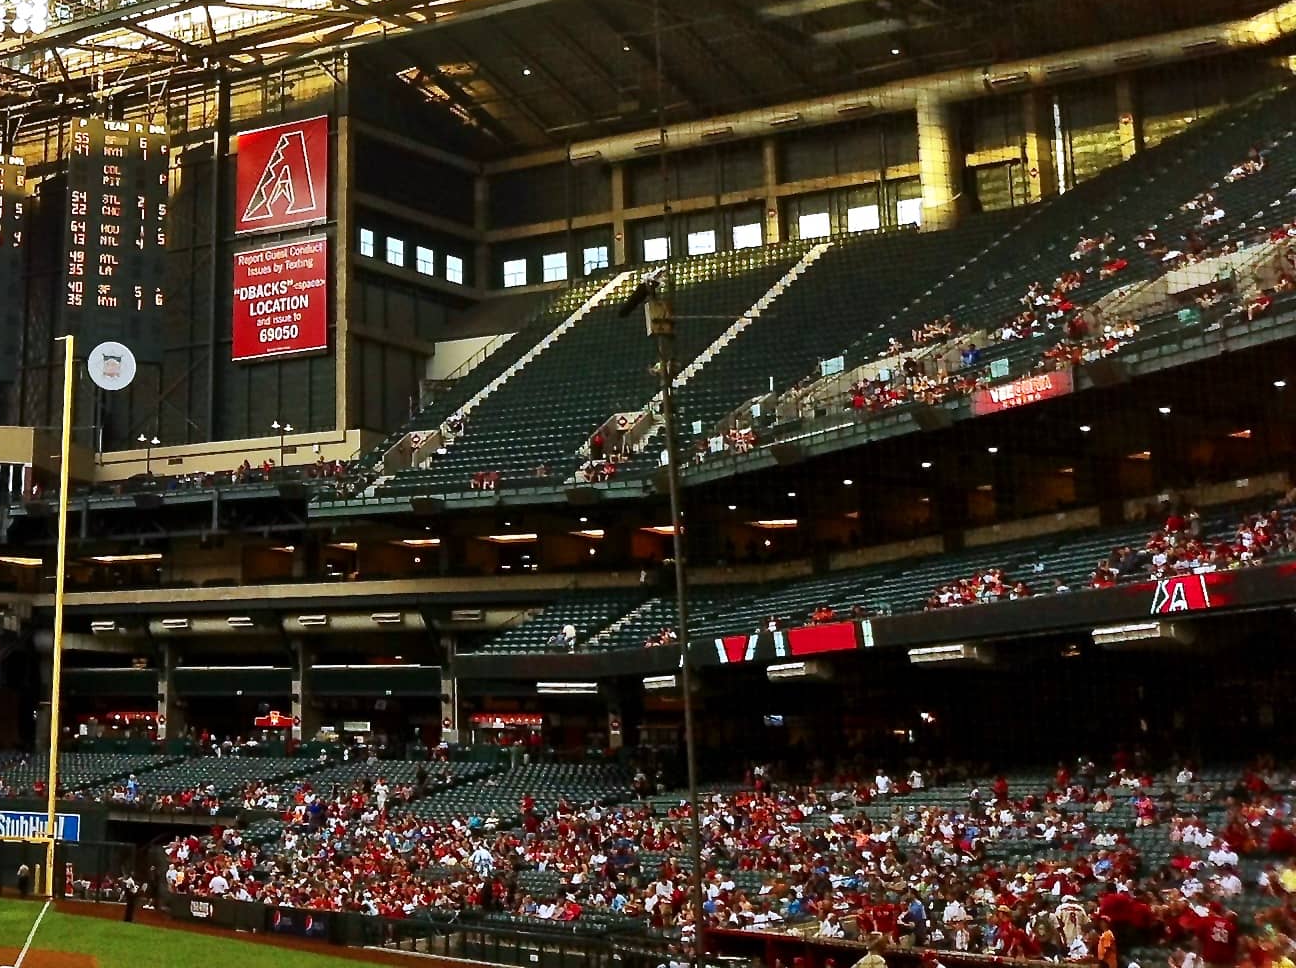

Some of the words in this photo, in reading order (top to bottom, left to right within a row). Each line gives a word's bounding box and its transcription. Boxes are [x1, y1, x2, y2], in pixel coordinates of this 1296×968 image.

[103, 120, 130, 132] TEAM
[103, 164, 122, 176] COL
[102, 175, 121, 187] PIT
[101, 193, 121, 206] STL
[100, 223, 120, 235] HOU
[99, 253, 119, 265] ATL
[238, 251, 264, 267] Report
[265, 248, 288, 262] Guest
[290, 242, 323, 257] Conduct
[98, 264, 113, 276] LA
[248, 265, 272, 277] Issues
[273, 262, 284, 274] by
[285, 258, 314, 270] Texting
[250, 294, 309, 317] LOCATION
[257, 316, 271, 327] and
[272, 314, 293, 325] issue
[293, 312, 302, 322] to
[260, 324, 299, 343] 69050
